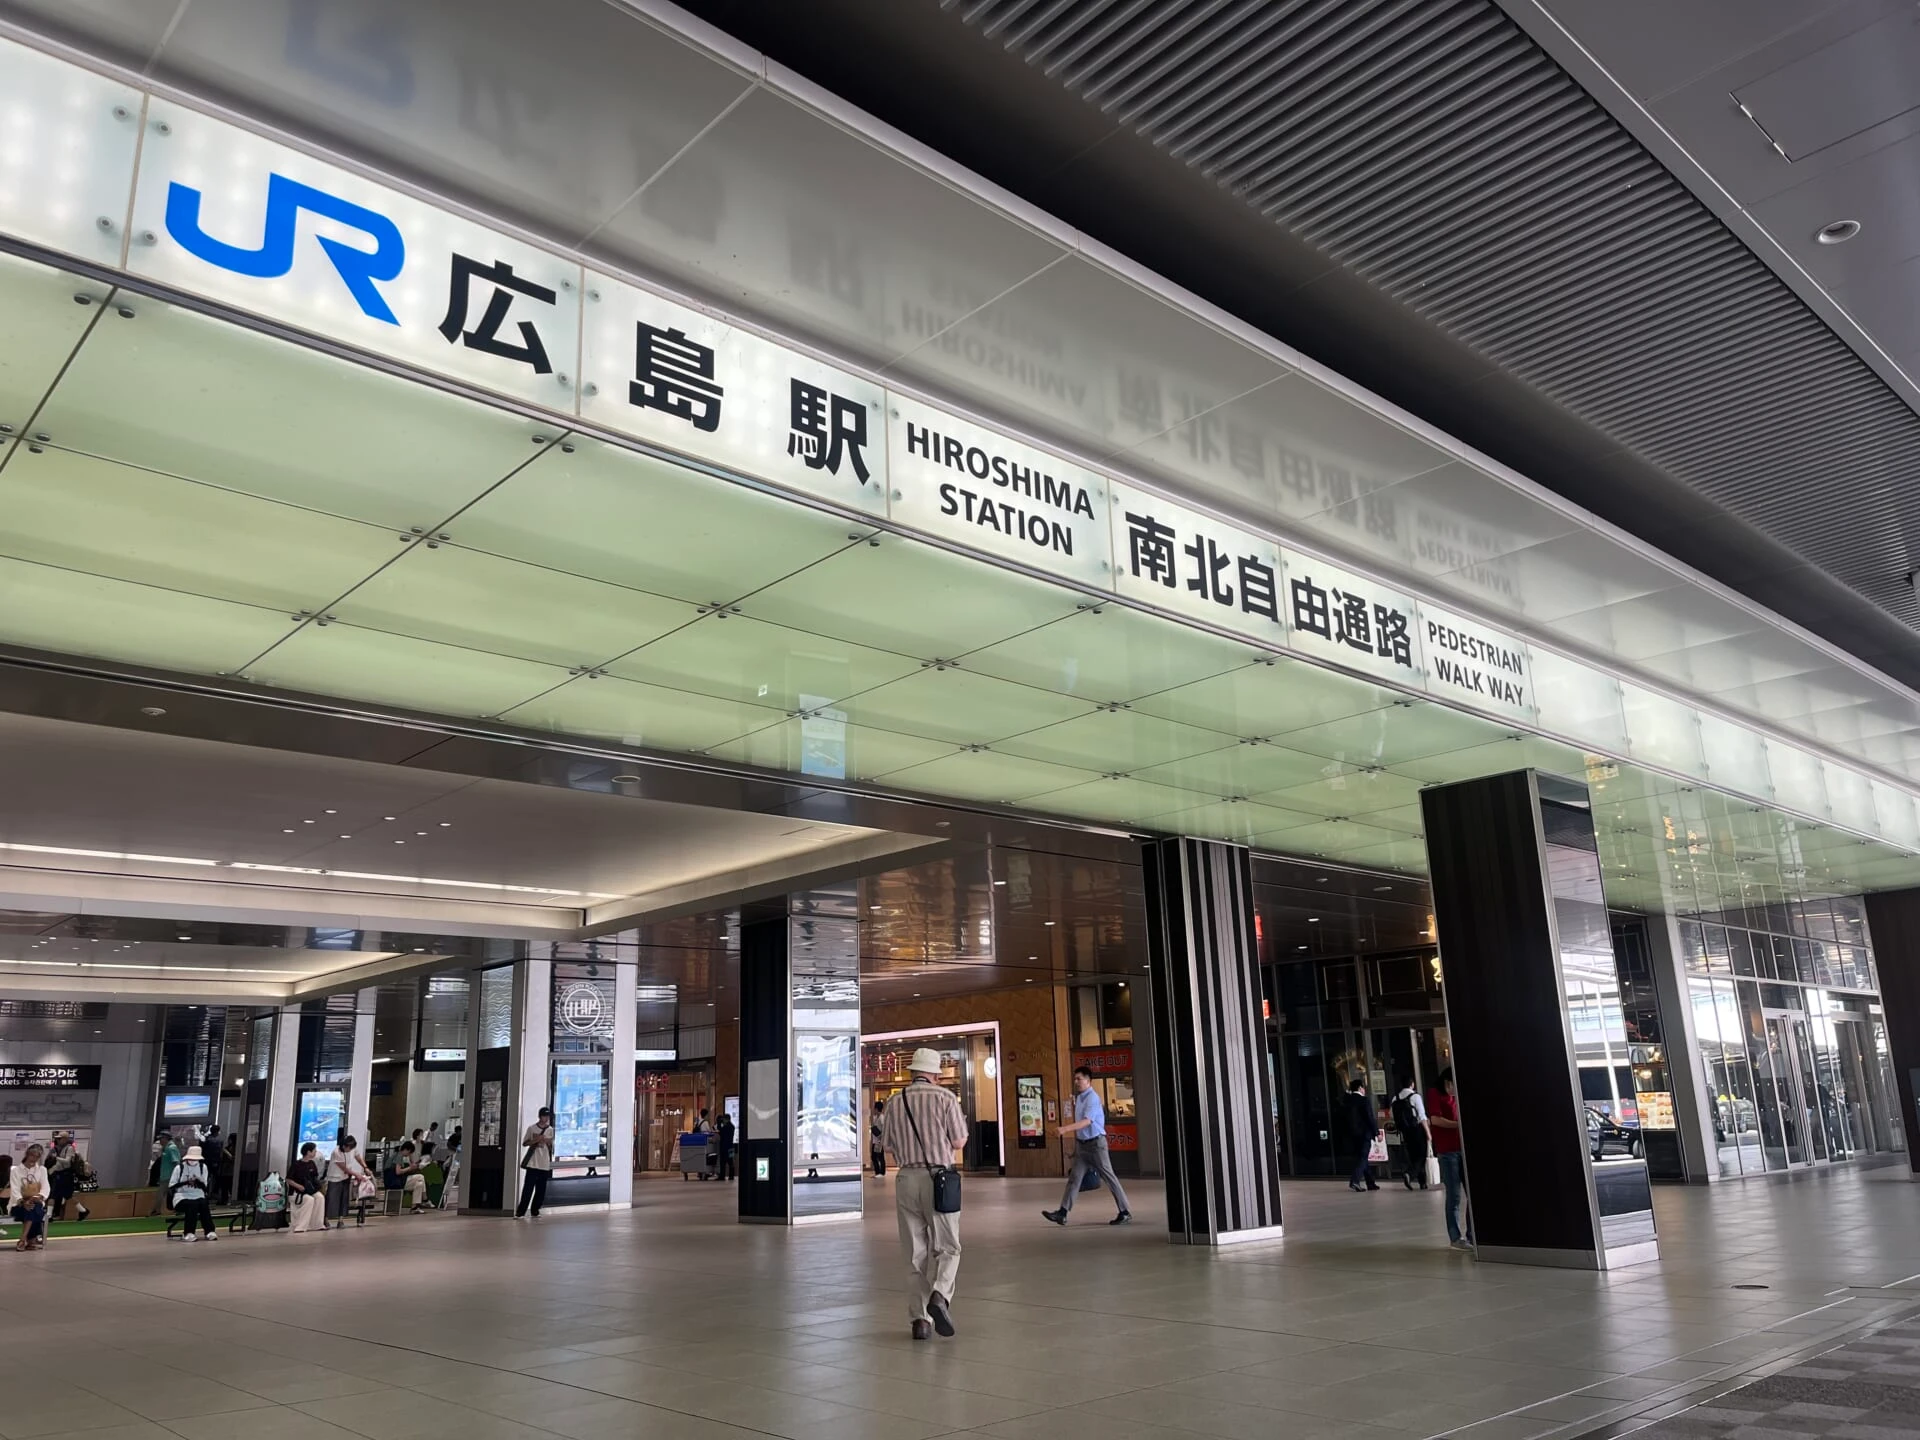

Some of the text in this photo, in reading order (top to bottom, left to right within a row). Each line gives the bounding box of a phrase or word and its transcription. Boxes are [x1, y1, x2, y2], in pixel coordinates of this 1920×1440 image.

[165, 172, 871, 486] JR 広島駅
[907, 422, 1095, 520] HIROSHIMA
[939, 483, 1073, 556] STATION
[1125, 511, 1413, 668] 南北自由通路
[1428, 620, 1523, 676] PEDESTRIAN
[1434, 656, 1525, 707] WALK WAY
[1106, 1055, 1128, 1067] OUT
[1108, 1133, 1134, 1145] アウト
